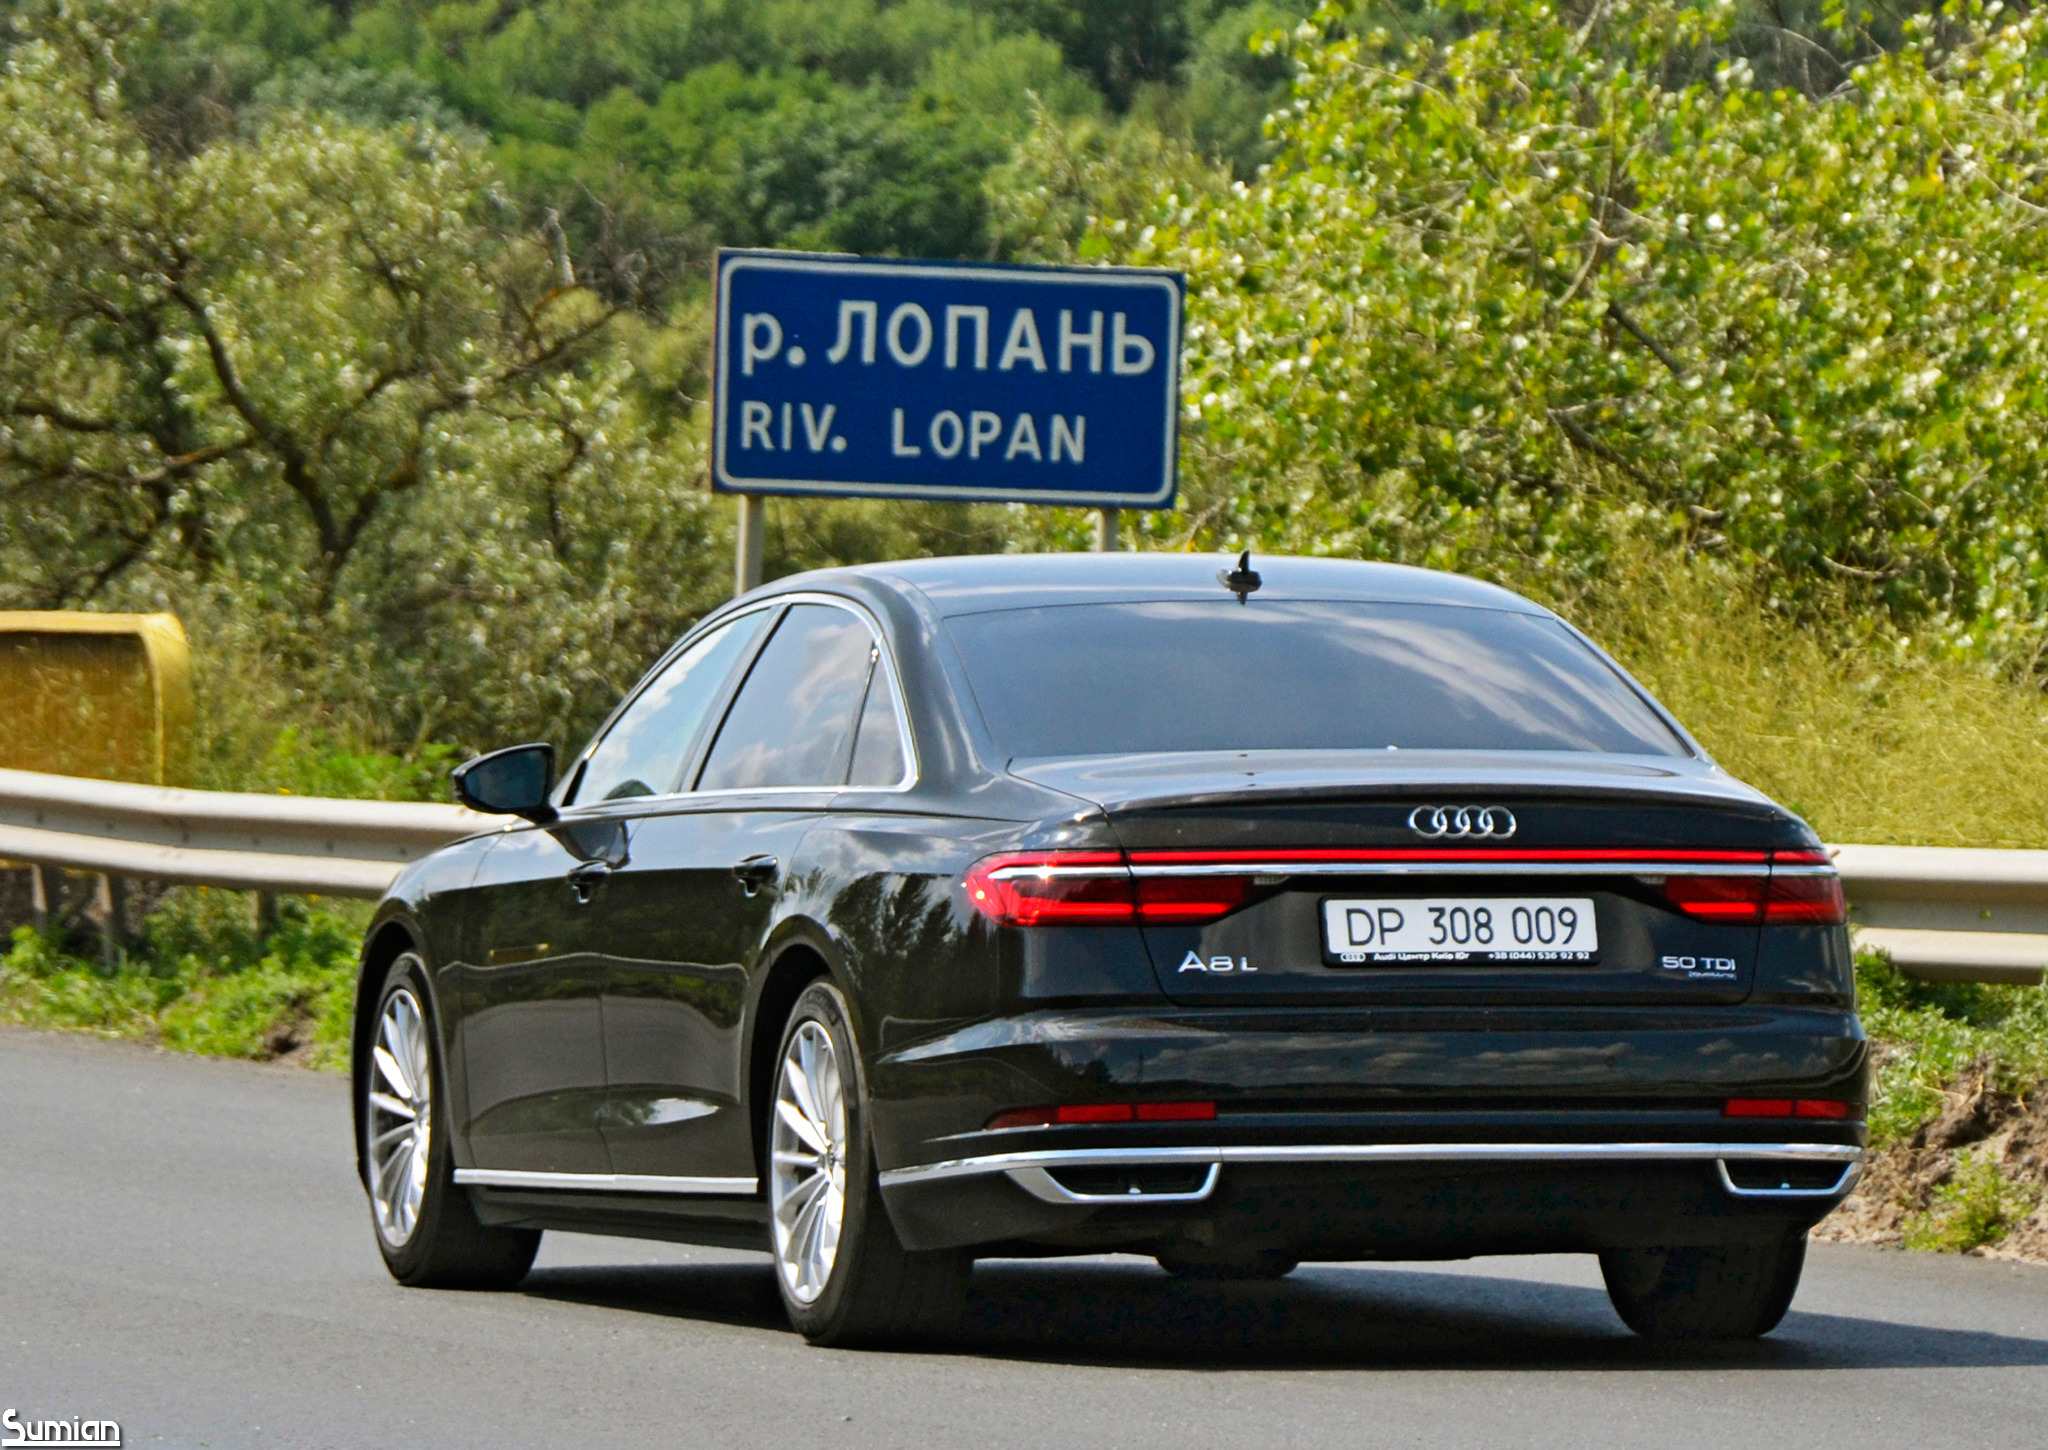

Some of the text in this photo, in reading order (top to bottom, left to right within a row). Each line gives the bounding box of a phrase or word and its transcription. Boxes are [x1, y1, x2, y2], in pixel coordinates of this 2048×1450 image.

[826, 300, 1156, 376] ЛОПАНЬ
[740, 400, 1086, 463] RIV. LOPAN
[1345, 906, 1578, 946] DP 308 009
[1177, 950, 1234, 972] A8
[1662, 956, 1736, 971] 50 TDI
